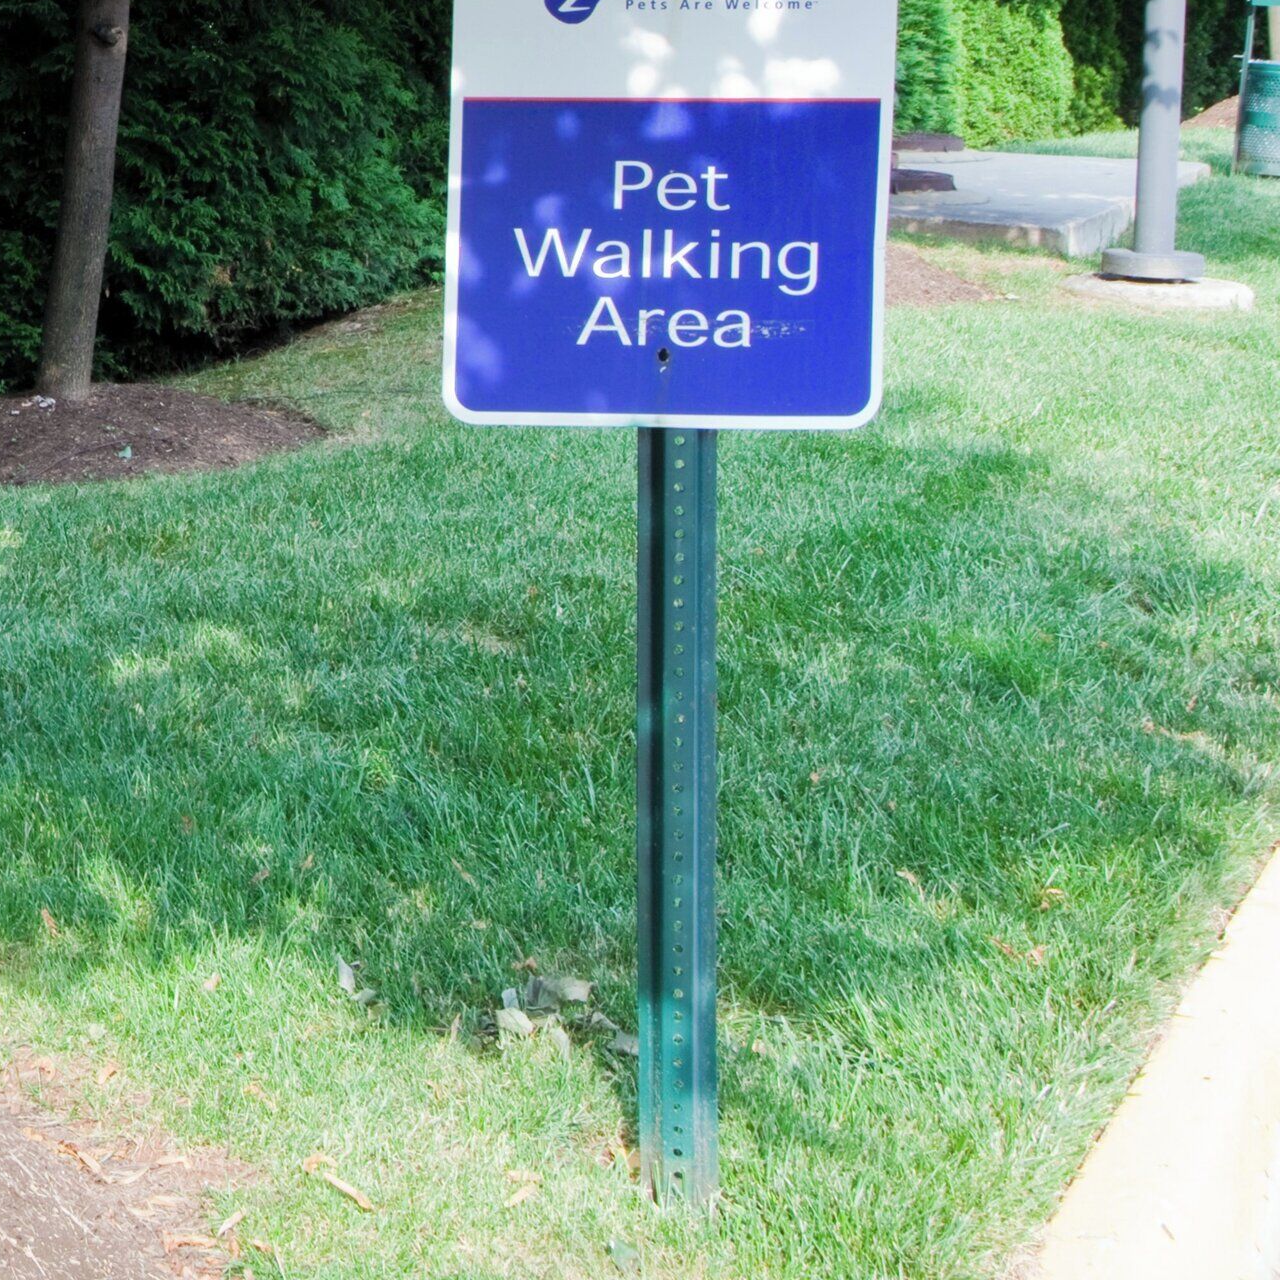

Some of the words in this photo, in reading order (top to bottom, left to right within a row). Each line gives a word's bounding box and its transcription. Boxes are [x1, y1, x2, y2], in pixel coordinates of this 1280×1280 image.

[613, 160, 731, 212] Pet
[513, 227, 819, 296] Walking
[575, 296, 752, 348] Area
